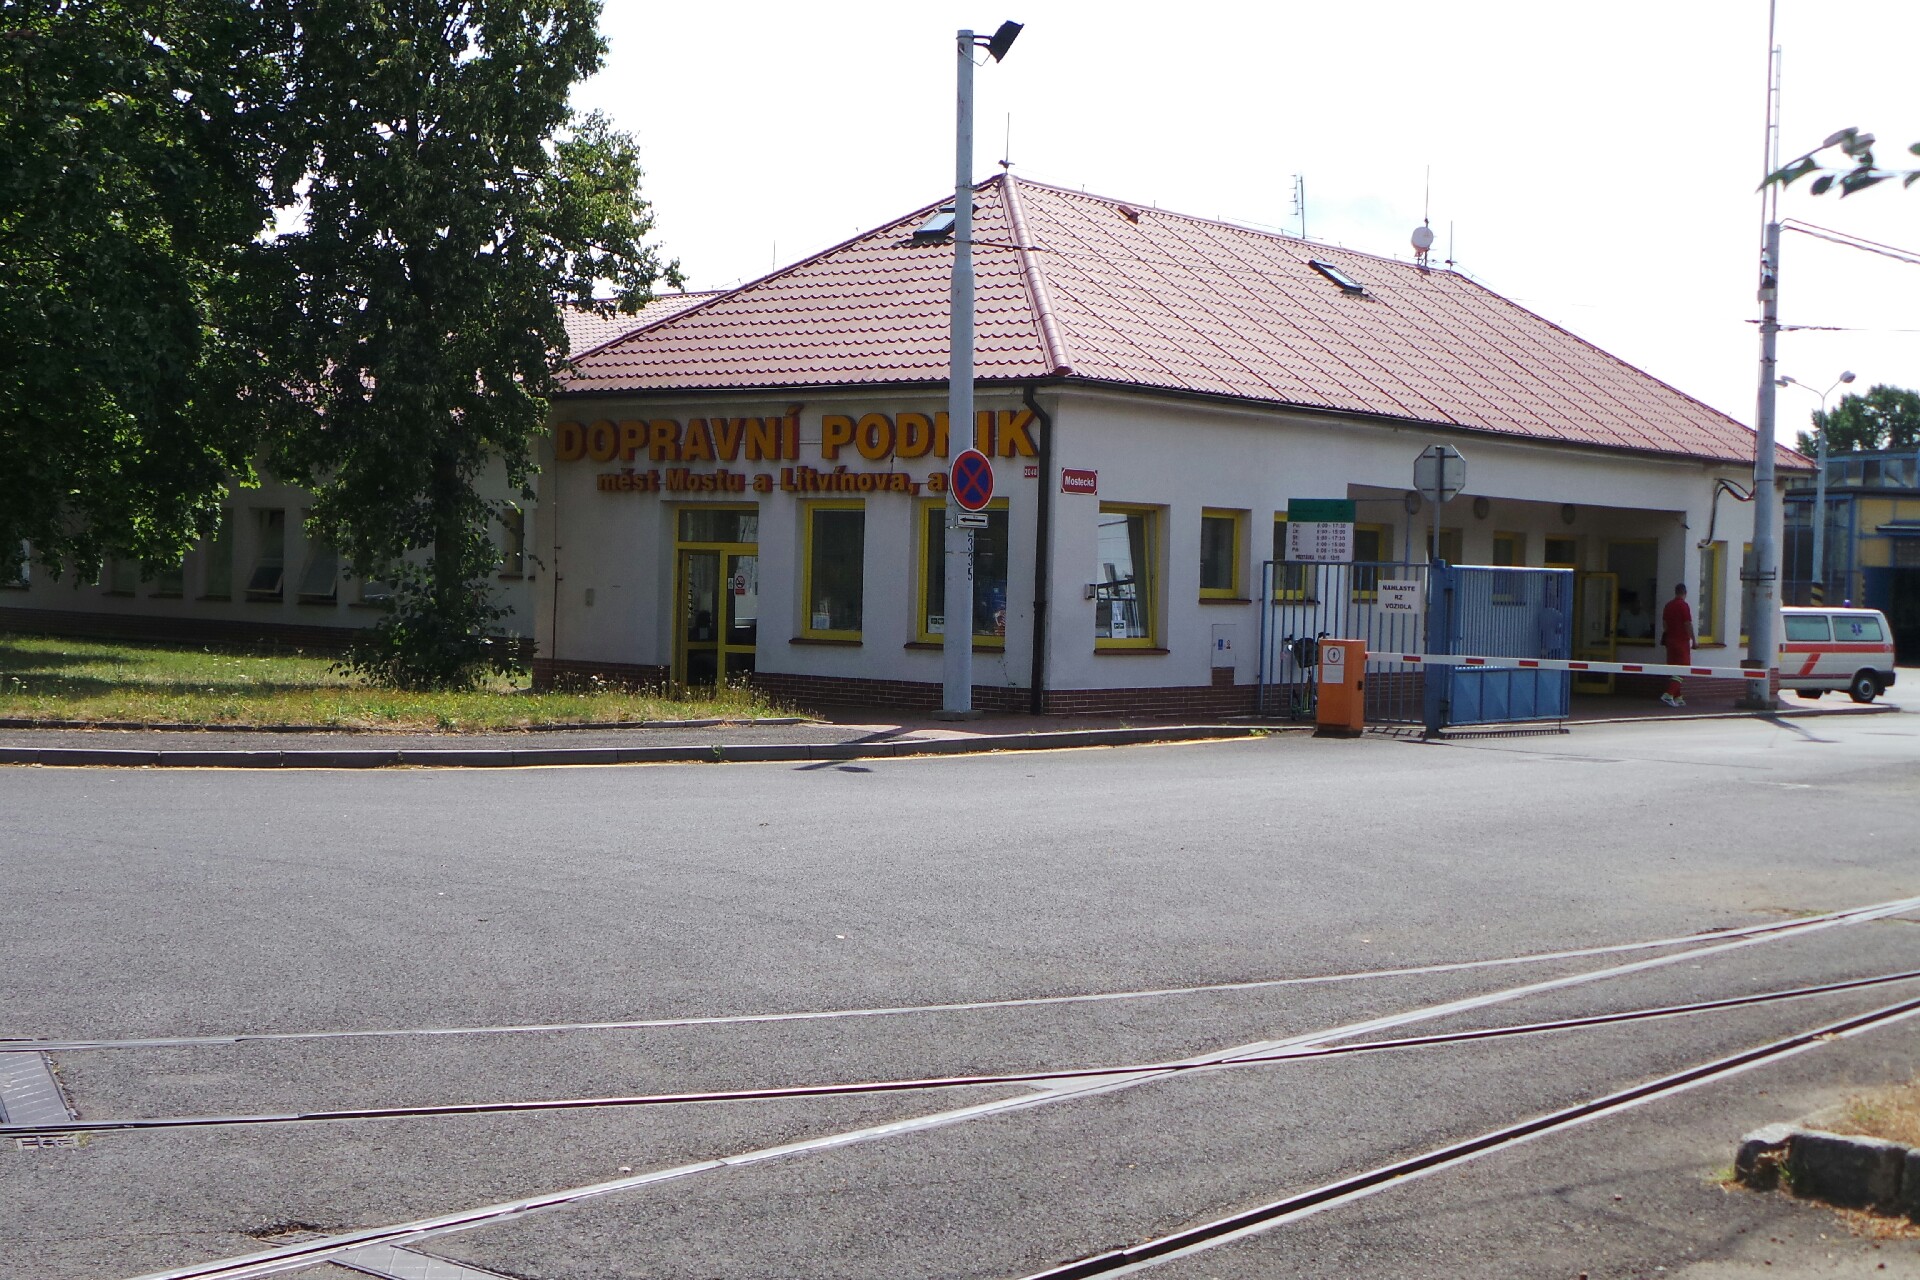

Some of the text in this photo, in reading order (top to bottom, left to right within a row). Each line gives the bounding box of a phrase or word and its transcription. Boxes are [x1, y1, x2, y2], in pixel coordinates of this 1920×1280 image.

[557, 403, 803, 462] DOPRAVNÍ
[597, 468, 661, 493] měst
[665, 468, 747, 493] Mostu
[752, 473, 773, 493] a
[780, 465, 919, 496] Litvínova,
[1064, 475, 1095, 487] Mostecká
